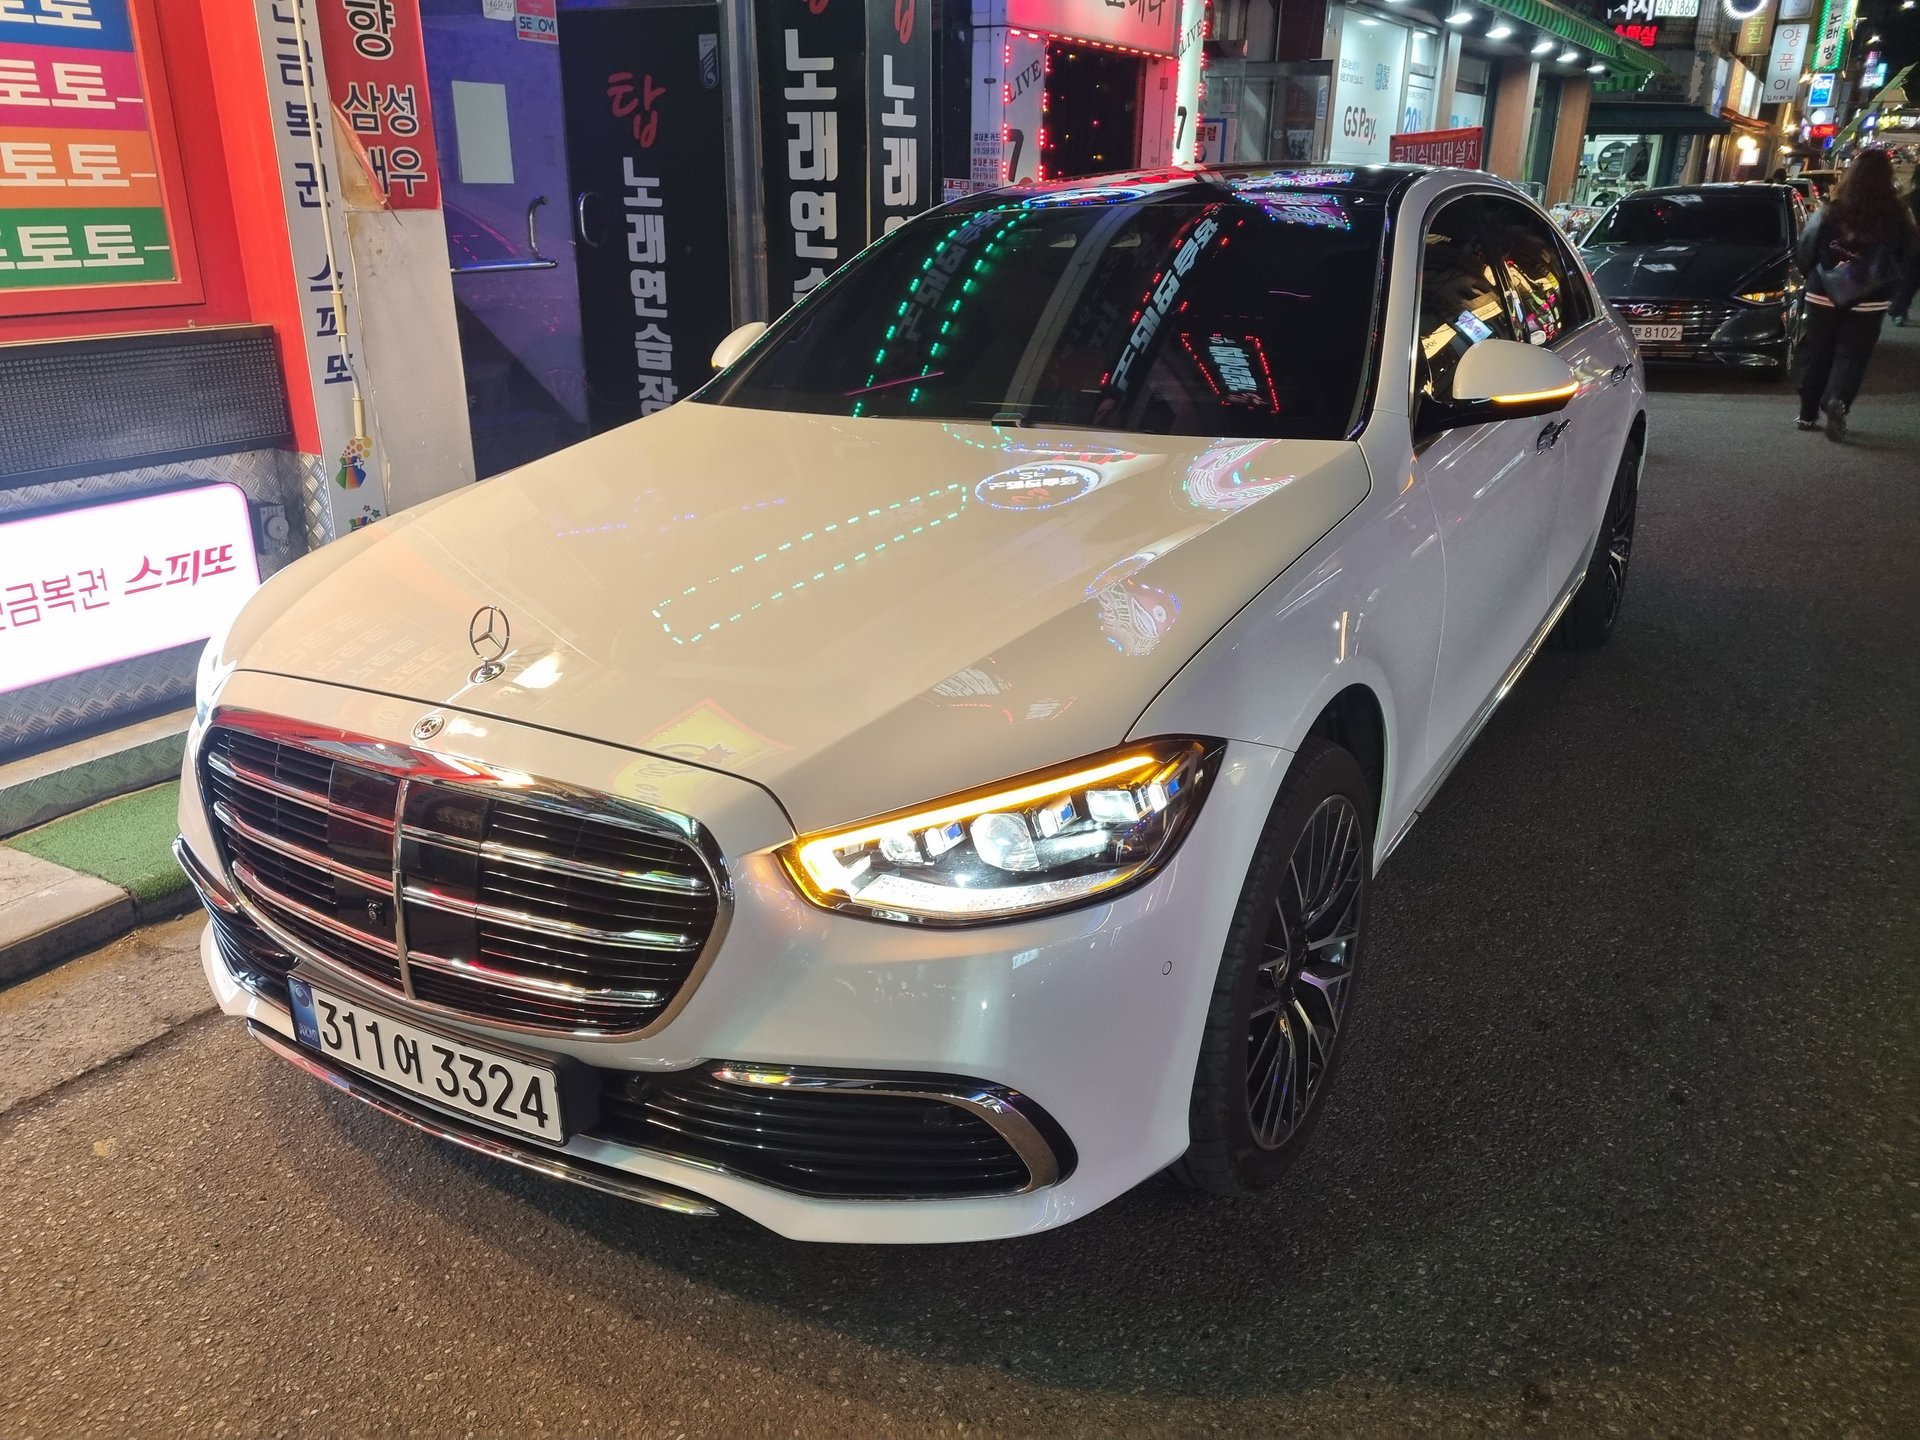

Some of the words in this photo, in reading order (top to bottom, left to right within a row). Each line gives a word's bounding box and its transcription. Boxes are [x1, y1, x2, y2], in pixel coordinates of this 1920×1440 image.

[1675, 0, 1696, 15] 1866
[1179, 20, 1203, 57] LIVE
[1773, 28, 1802, 92] 양푼이
[1008, 59, 1043, 104] LIVE
[1811, 89, 1829, 99] 25
[343, 83, 418, 137] 삼성
[0, 142, 130, 187] 토토
[622, 156, 679, 417] 노래연습장
[1644, 327, 1678, 339] 8102
[0, 568, 110, 631] 금복권
[124, 544, 237, 596] 스피또
[299, 1022, 319, 1042] KOR
[431, 1044, 549, 1129] 3324
